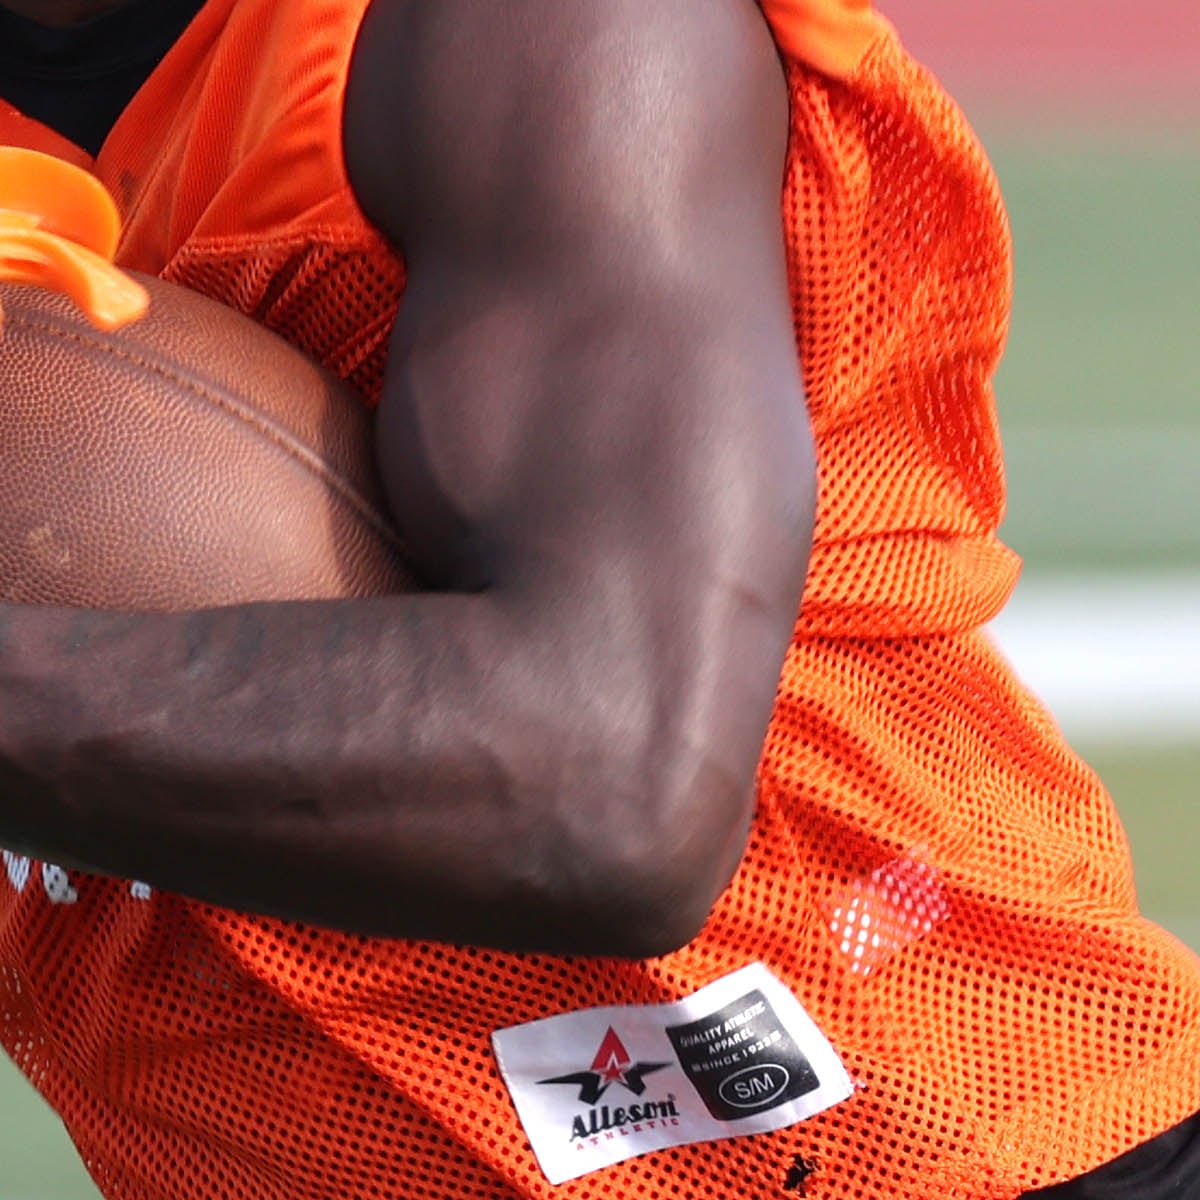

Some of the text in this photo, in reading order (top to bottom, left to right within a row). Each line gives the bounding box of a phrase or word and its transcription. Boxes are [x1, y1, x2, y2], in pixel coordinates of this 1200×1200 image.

[680, 1024, 722, 1047] QUALITY
[709, 1027, 755, 1055] APPAREL
[702, 1052, 741, 1072] SINCE
[734, 1072, 775, 1099] S/M
[569, 1099, 680, 1142] Alleson
[576, 1117, 680, 1150] ATHLETIC
